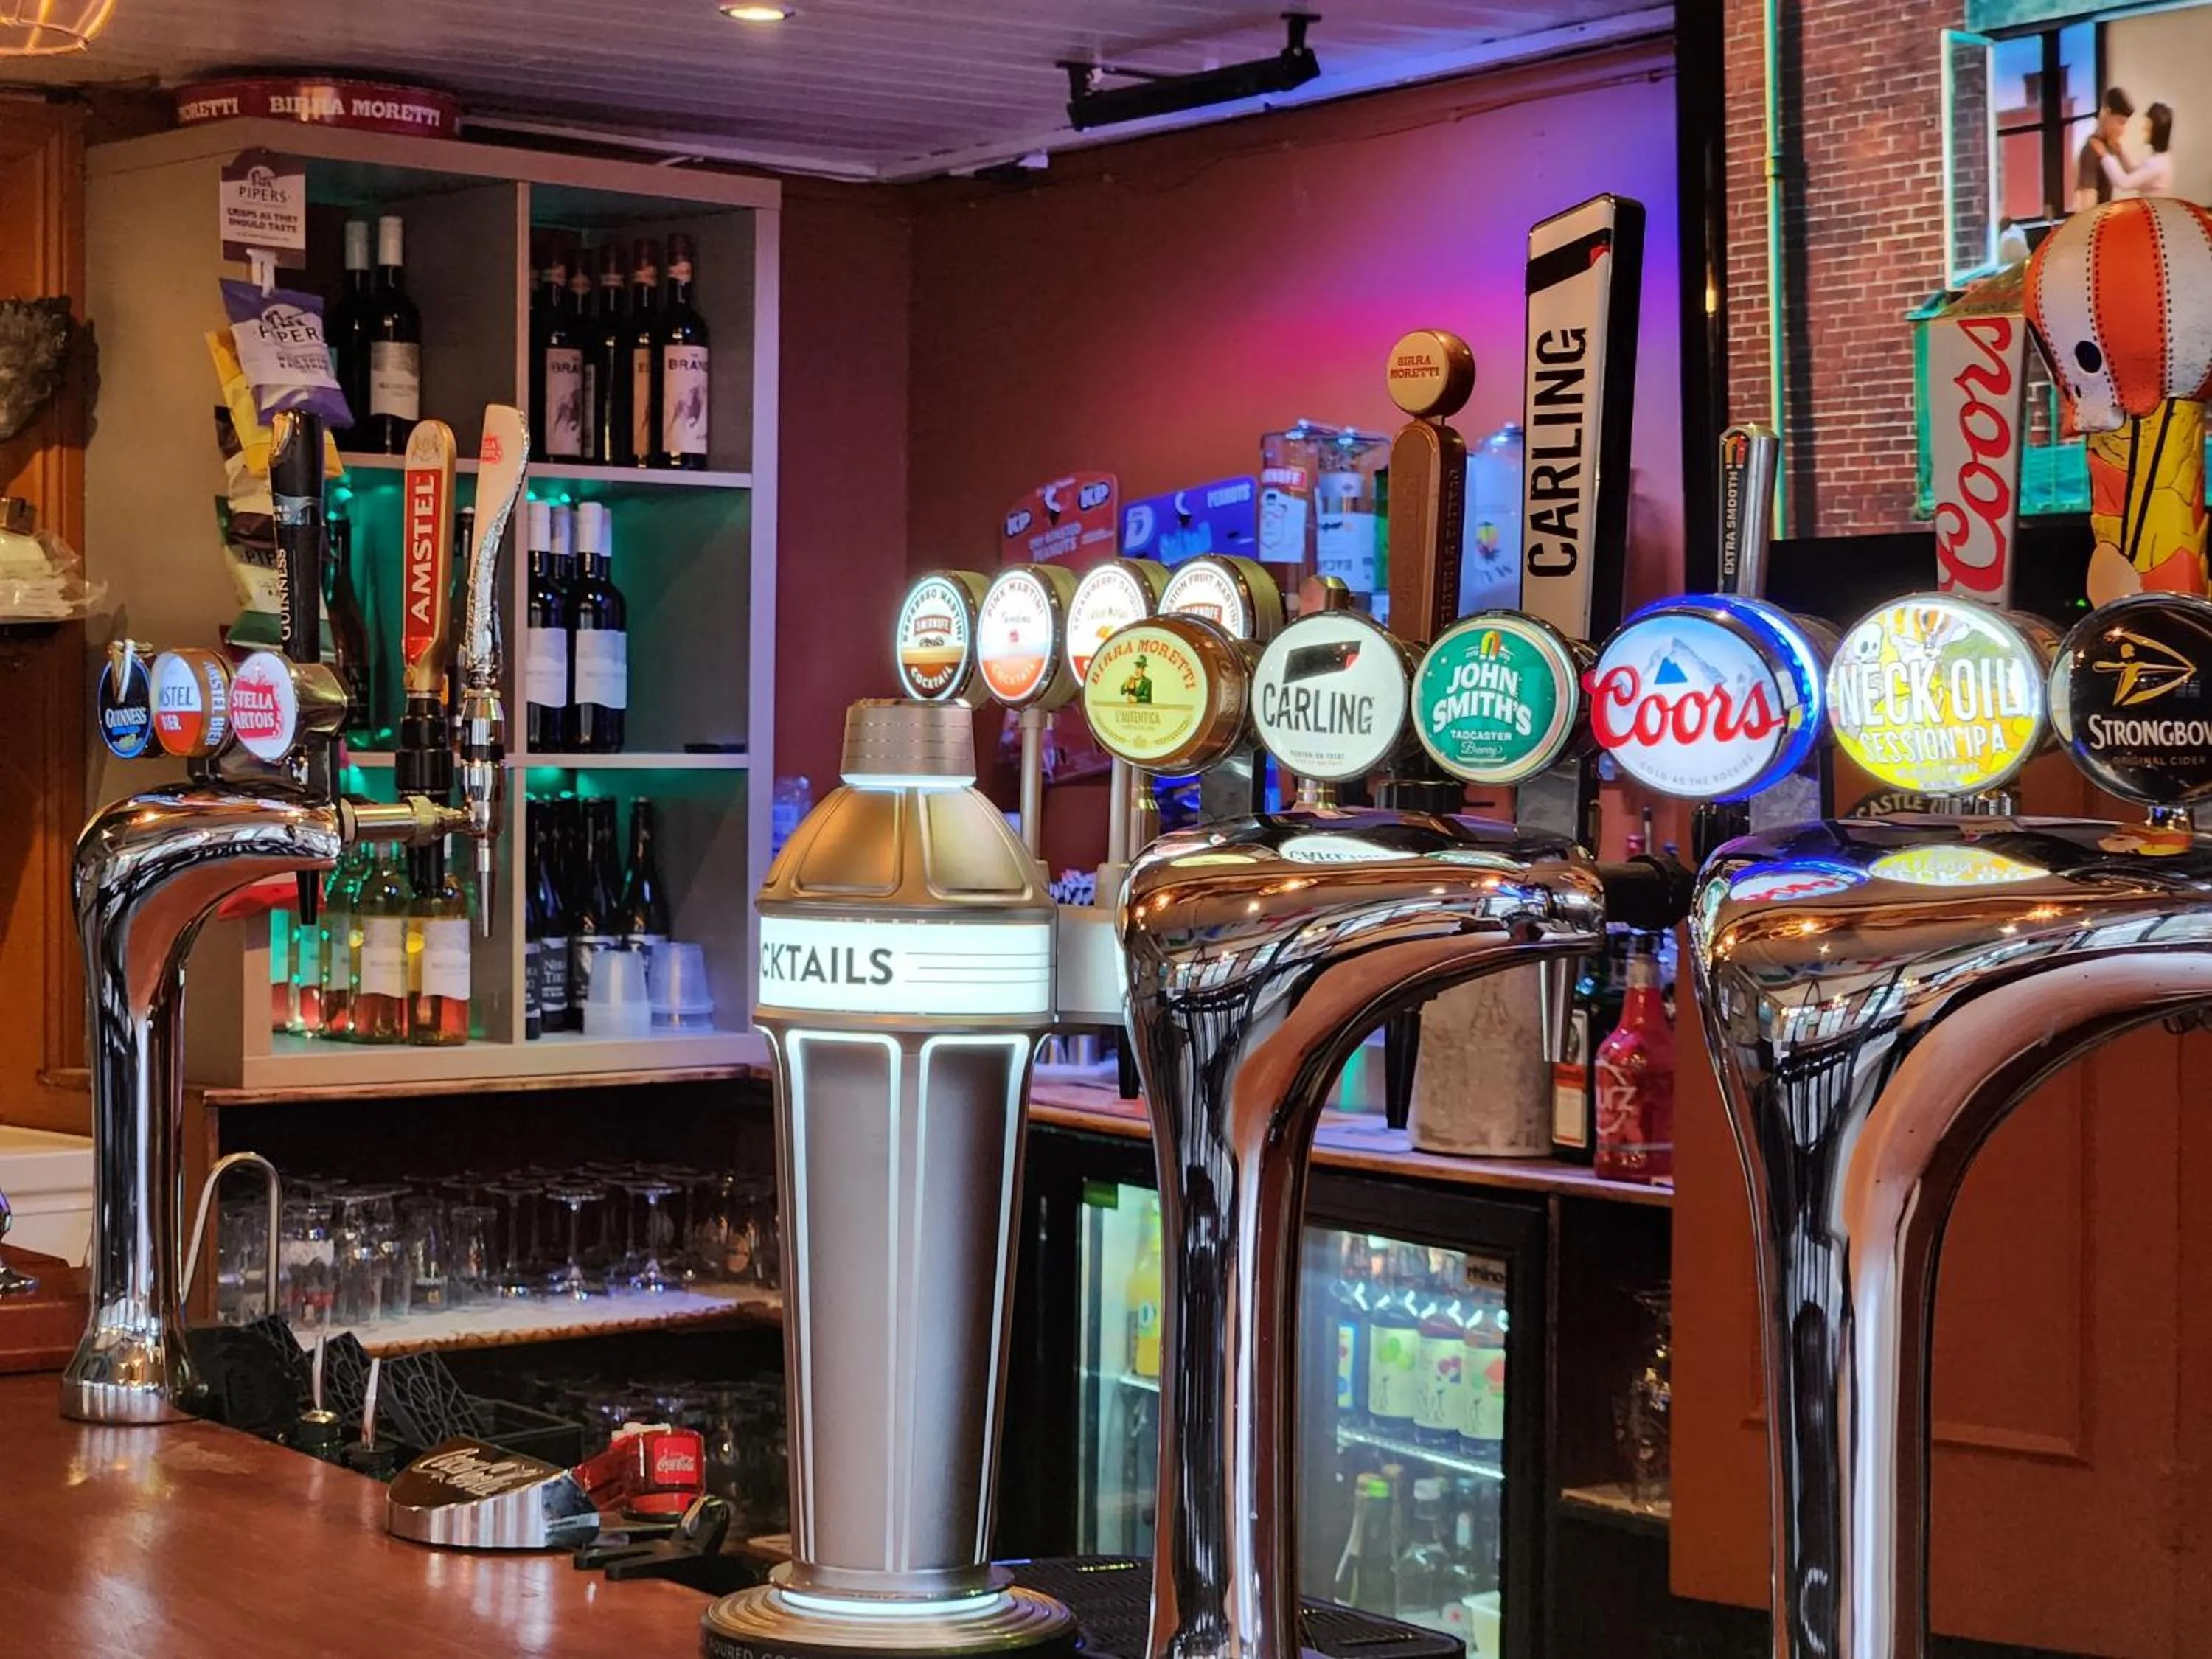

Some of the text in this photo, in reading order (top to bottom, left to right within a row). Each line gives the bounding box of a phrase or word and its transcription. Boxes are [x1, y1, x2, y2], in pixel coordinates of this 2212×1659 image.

[178, 97, 240, 120] ORETTI
[351, 97, 441, 127] MORETTI
[239, 185, 287, 203] PIPERS
[1390, 366, 1440, 379] MORETTI
[1397, 355, 1432, 366] BIRRA
[1526, 327, 1587, 578] CARLING
[1935, 316, 2012, 591] Coors
[1079, 482, 1110, 509] KP
[1725, 470, 1739, 528] SMOOTH
[411, 475, 435, 624] AMSTEL
[277, 548, 292, 641] GUINNESS
[1189, 574, 1215, 585] FRUIT
[1138, 639, 1197, 690] MORETTI
[1446, 661, 1519, 698] JOHN
[232, 690, 274, 710] STELLA
[1582, 665, 1787, 750] Coors
[1837, 657, 2028, 728] NECK OIL
[105, 706, 147, 728] GUINNESS
[232, 711, 275, 729] ARTOIS
[1263, 682, 1374, 735] CARLING
[1433, 689, 1532, 737] SMITH'S
[1450, 729, 1512, 741] TADCASTER
[1859, 723, 2008, 765] SESSION IPA
[2169, 755, 2207, 765] CIDER
[1856, 793, 1924, 818] CASTLE
